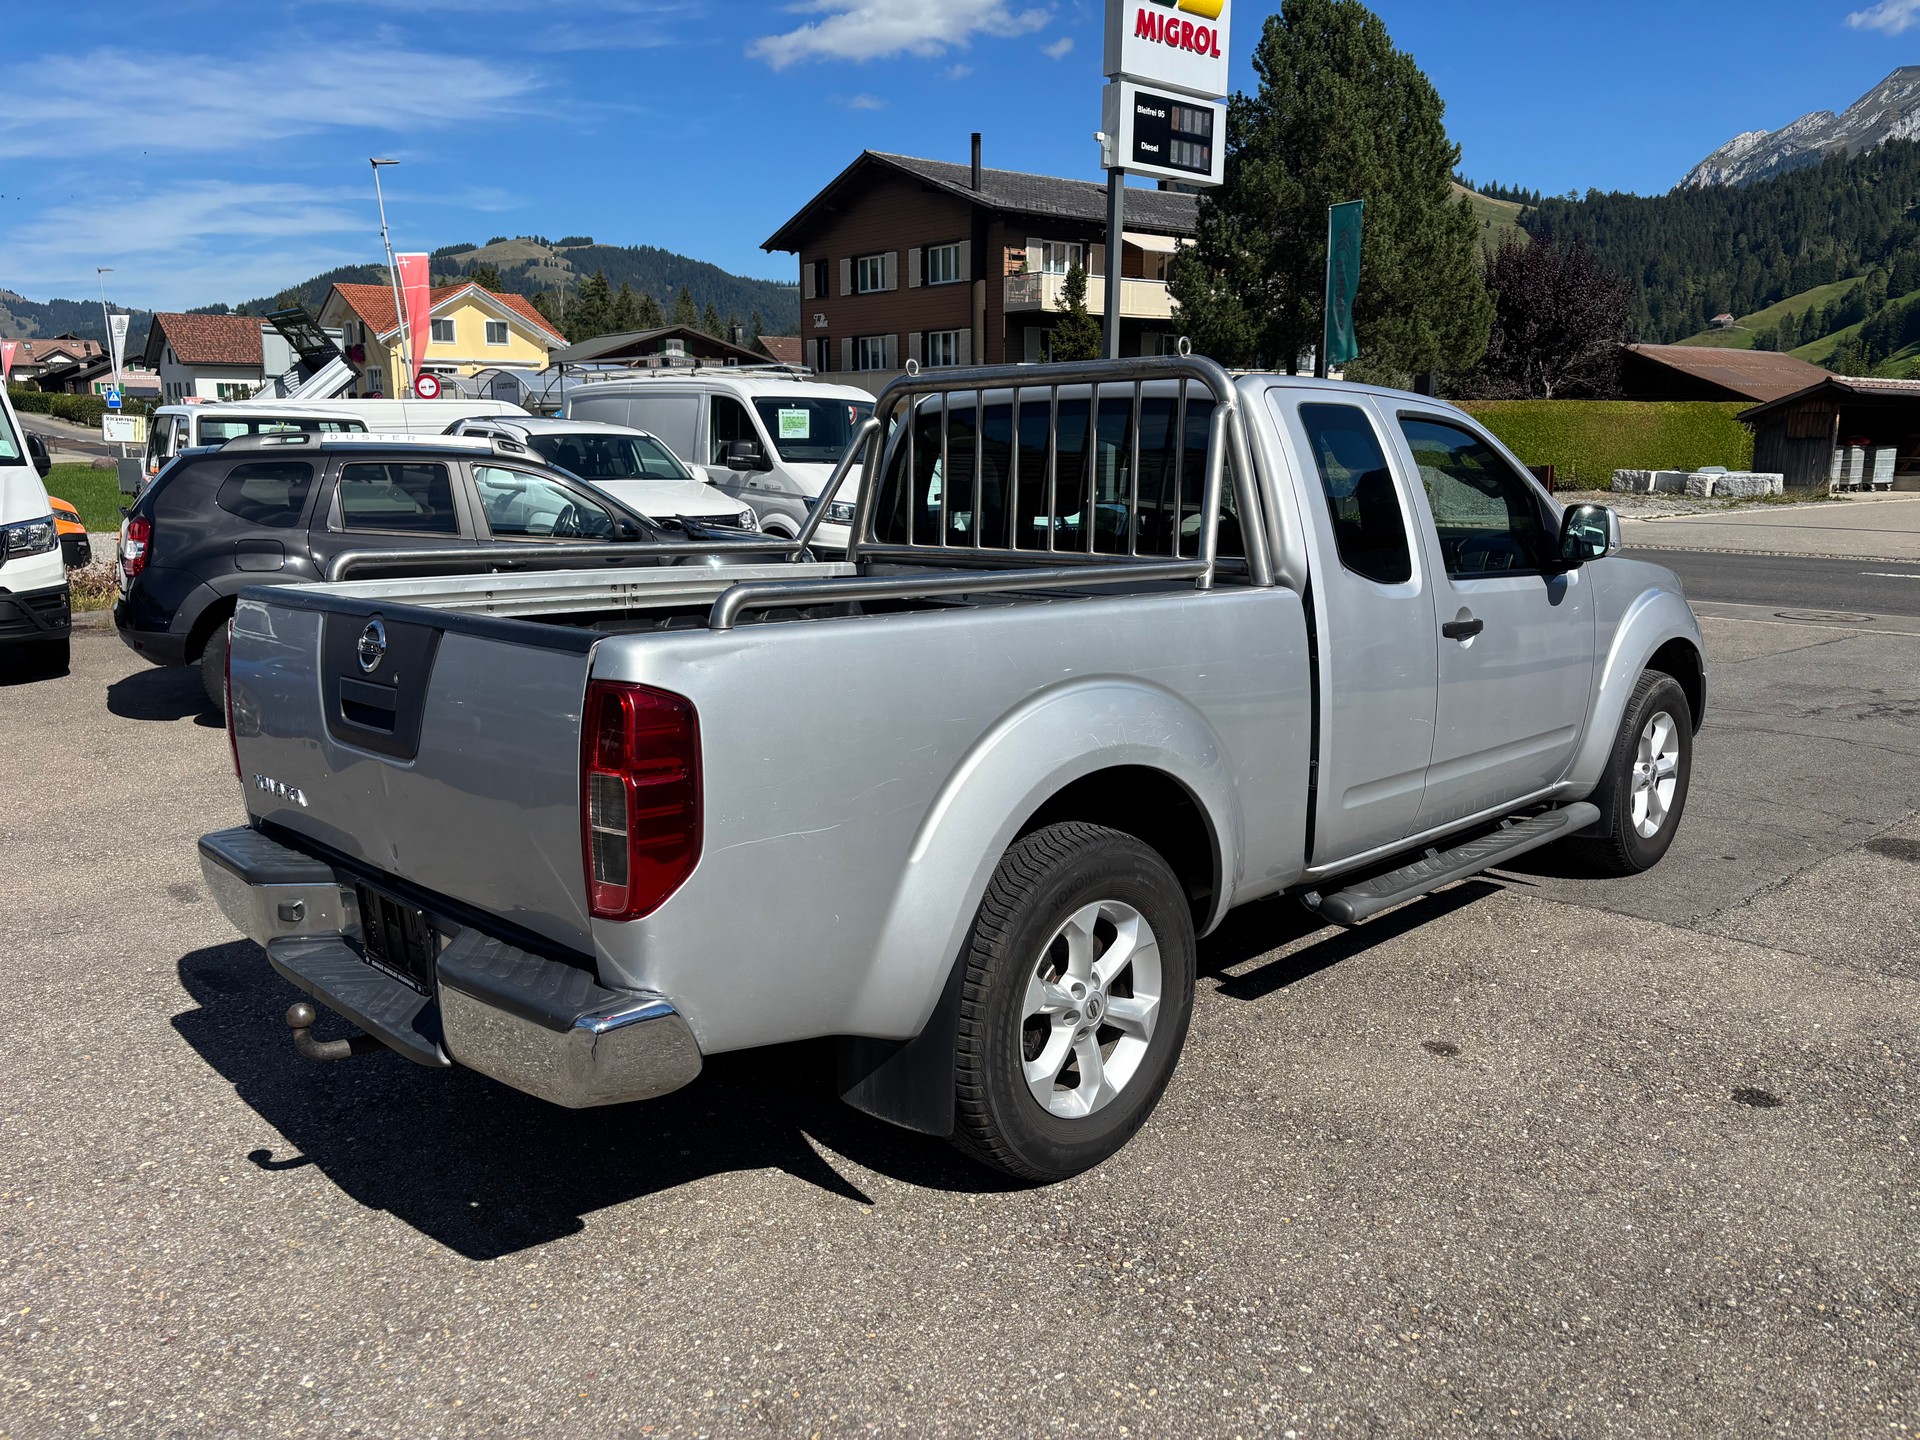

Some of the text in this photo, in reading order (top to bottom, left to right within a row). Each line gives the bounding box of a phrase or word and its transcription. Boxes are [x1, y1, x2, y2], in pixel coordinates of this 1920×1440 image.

[1135, 8, 1221, 57] MIGROL
[1137, 105, 1165, 118] Bleifrei 95
[1141, 141, 1159, 153] Diesel
[330, 434, 416, 442] DUSTER
